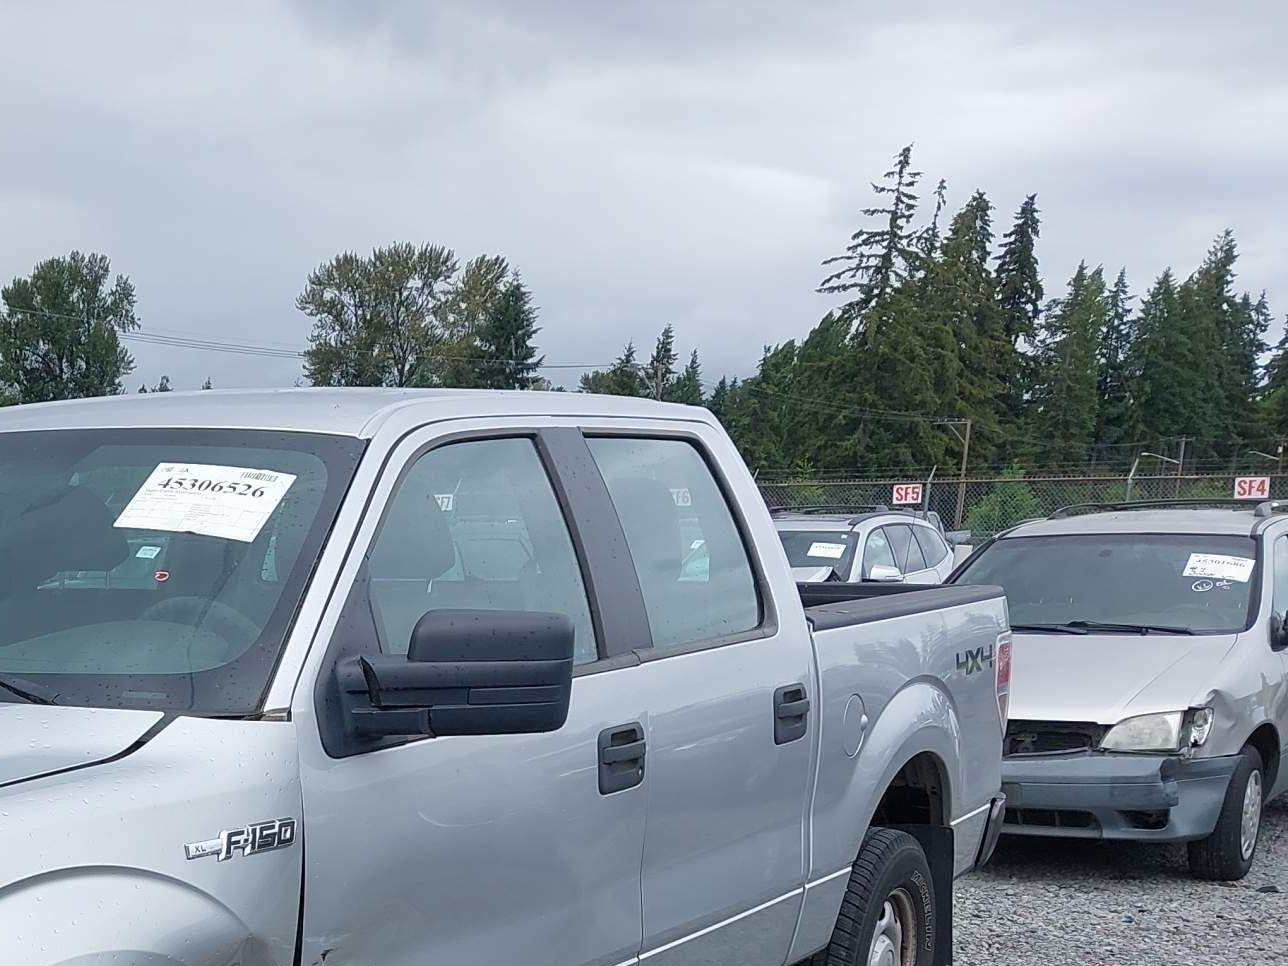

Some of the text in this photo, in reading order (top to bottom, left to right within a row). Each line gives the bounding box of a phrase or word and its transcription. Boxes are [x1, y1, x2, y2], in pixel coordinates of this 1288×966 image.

[157, 476, 266, 498] 45306526
[895, 486, 920, 502] SF5
[1237, 479, 1267, 496] SF4
